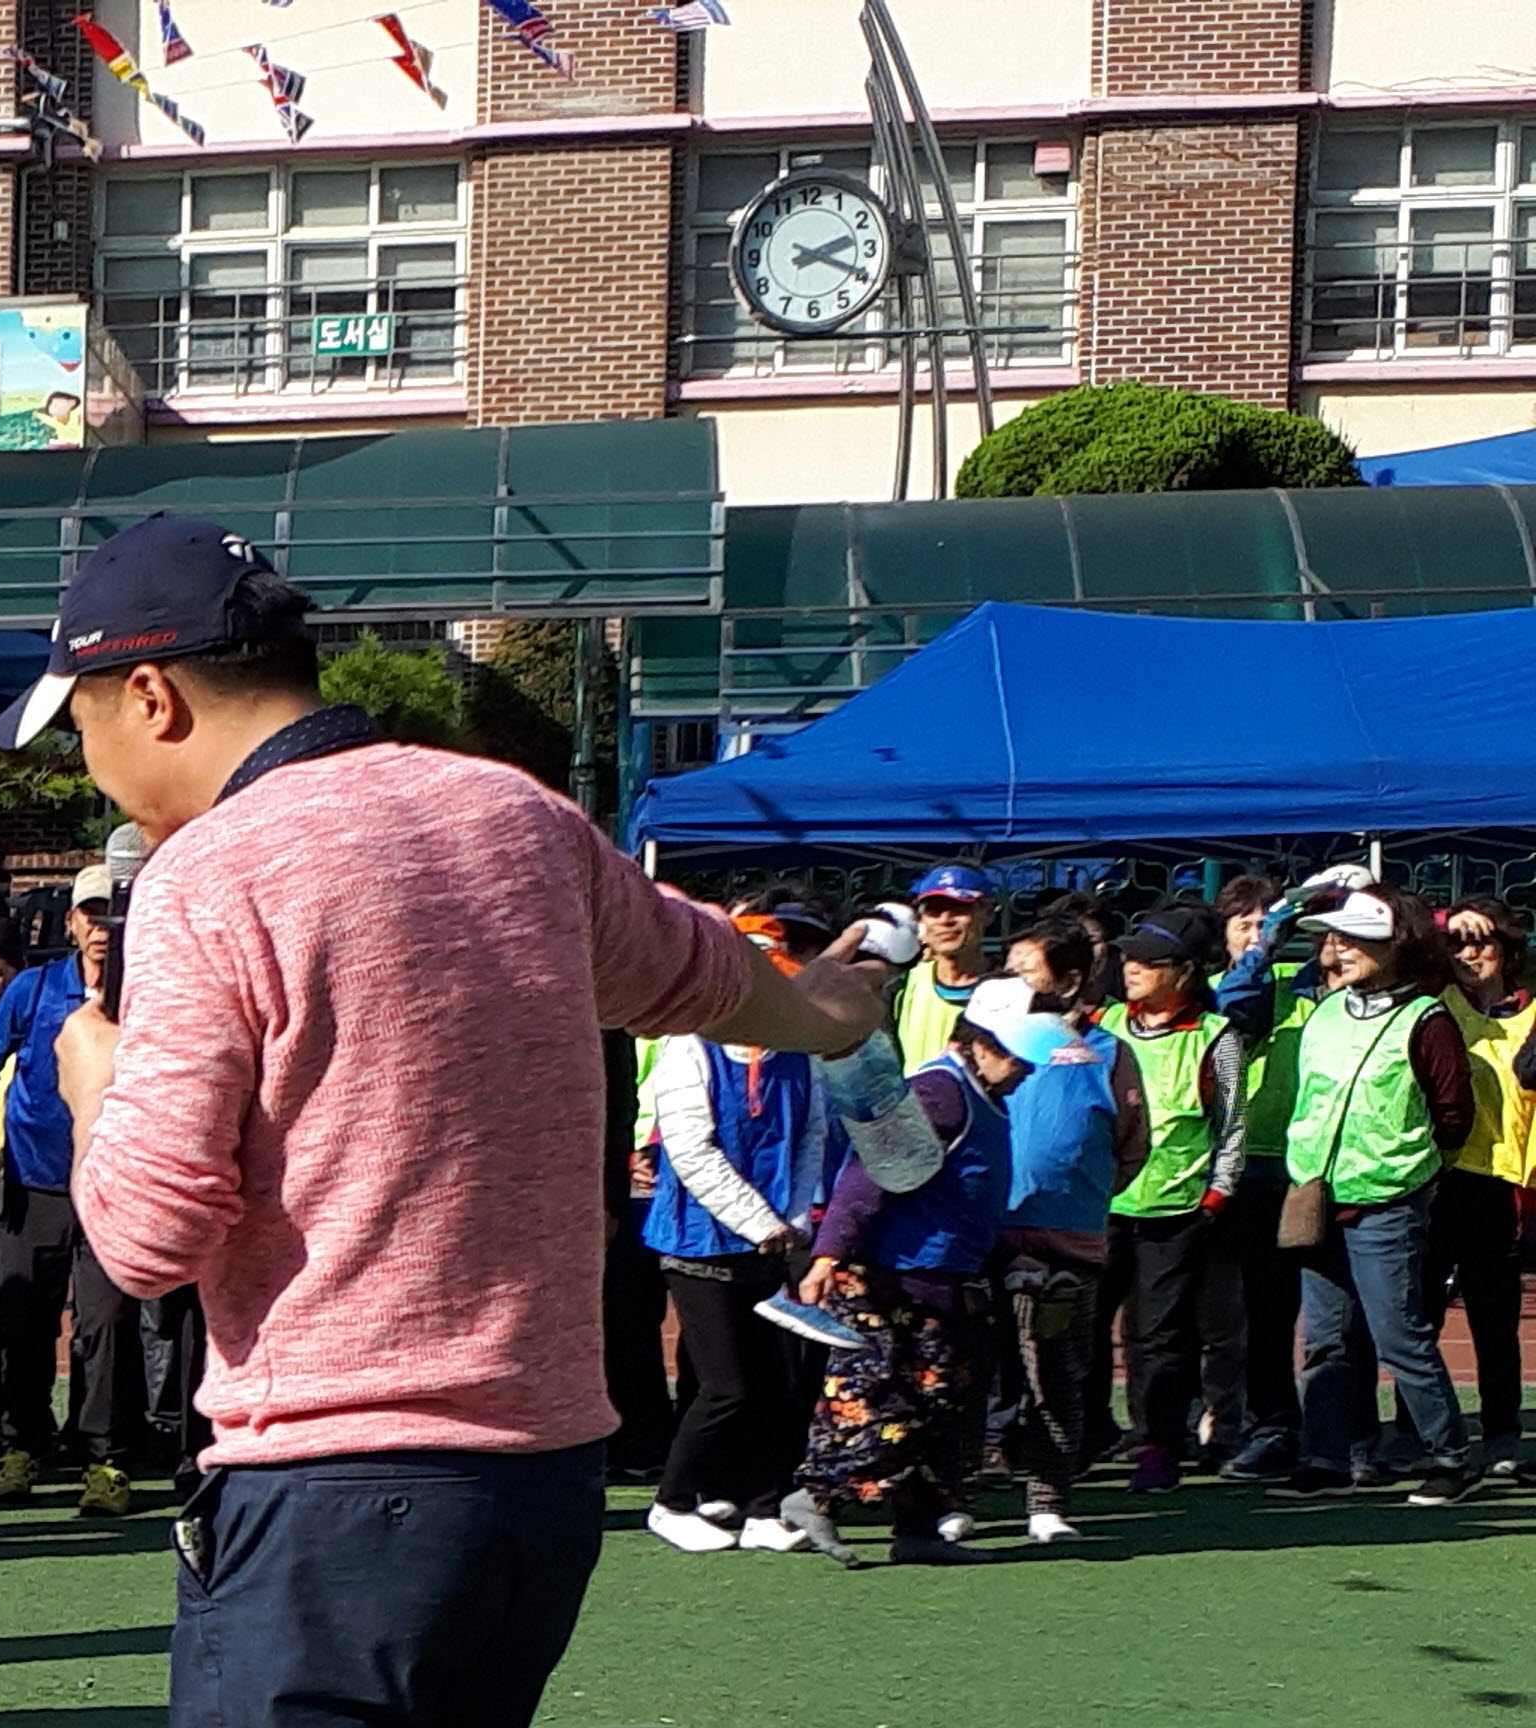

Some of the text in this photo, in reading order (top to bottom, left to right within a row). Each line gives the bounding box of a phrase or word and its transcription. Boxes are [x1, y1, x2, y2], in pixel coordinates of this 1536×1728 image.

[799, 186, 823, 206] 12
[834, 193, 843, 212] 1
[773, 197, 792, 215] 11
[753, 221, 774, 238] 10
[855, 211, 869, 229] 2
[863, 239, 877, 258] 3
[748, 250, 761, 268] 9
[854, 267, 869, 285] 4
[756, 277, 770, 295] 8
[779, 296, 793, 316] 7
[807, 300, 821, 319] 6
[837, 290, 851, 310] 5
[318, 317, 389, 351] 도서실
[69, 630, 104, 652] TOUR
